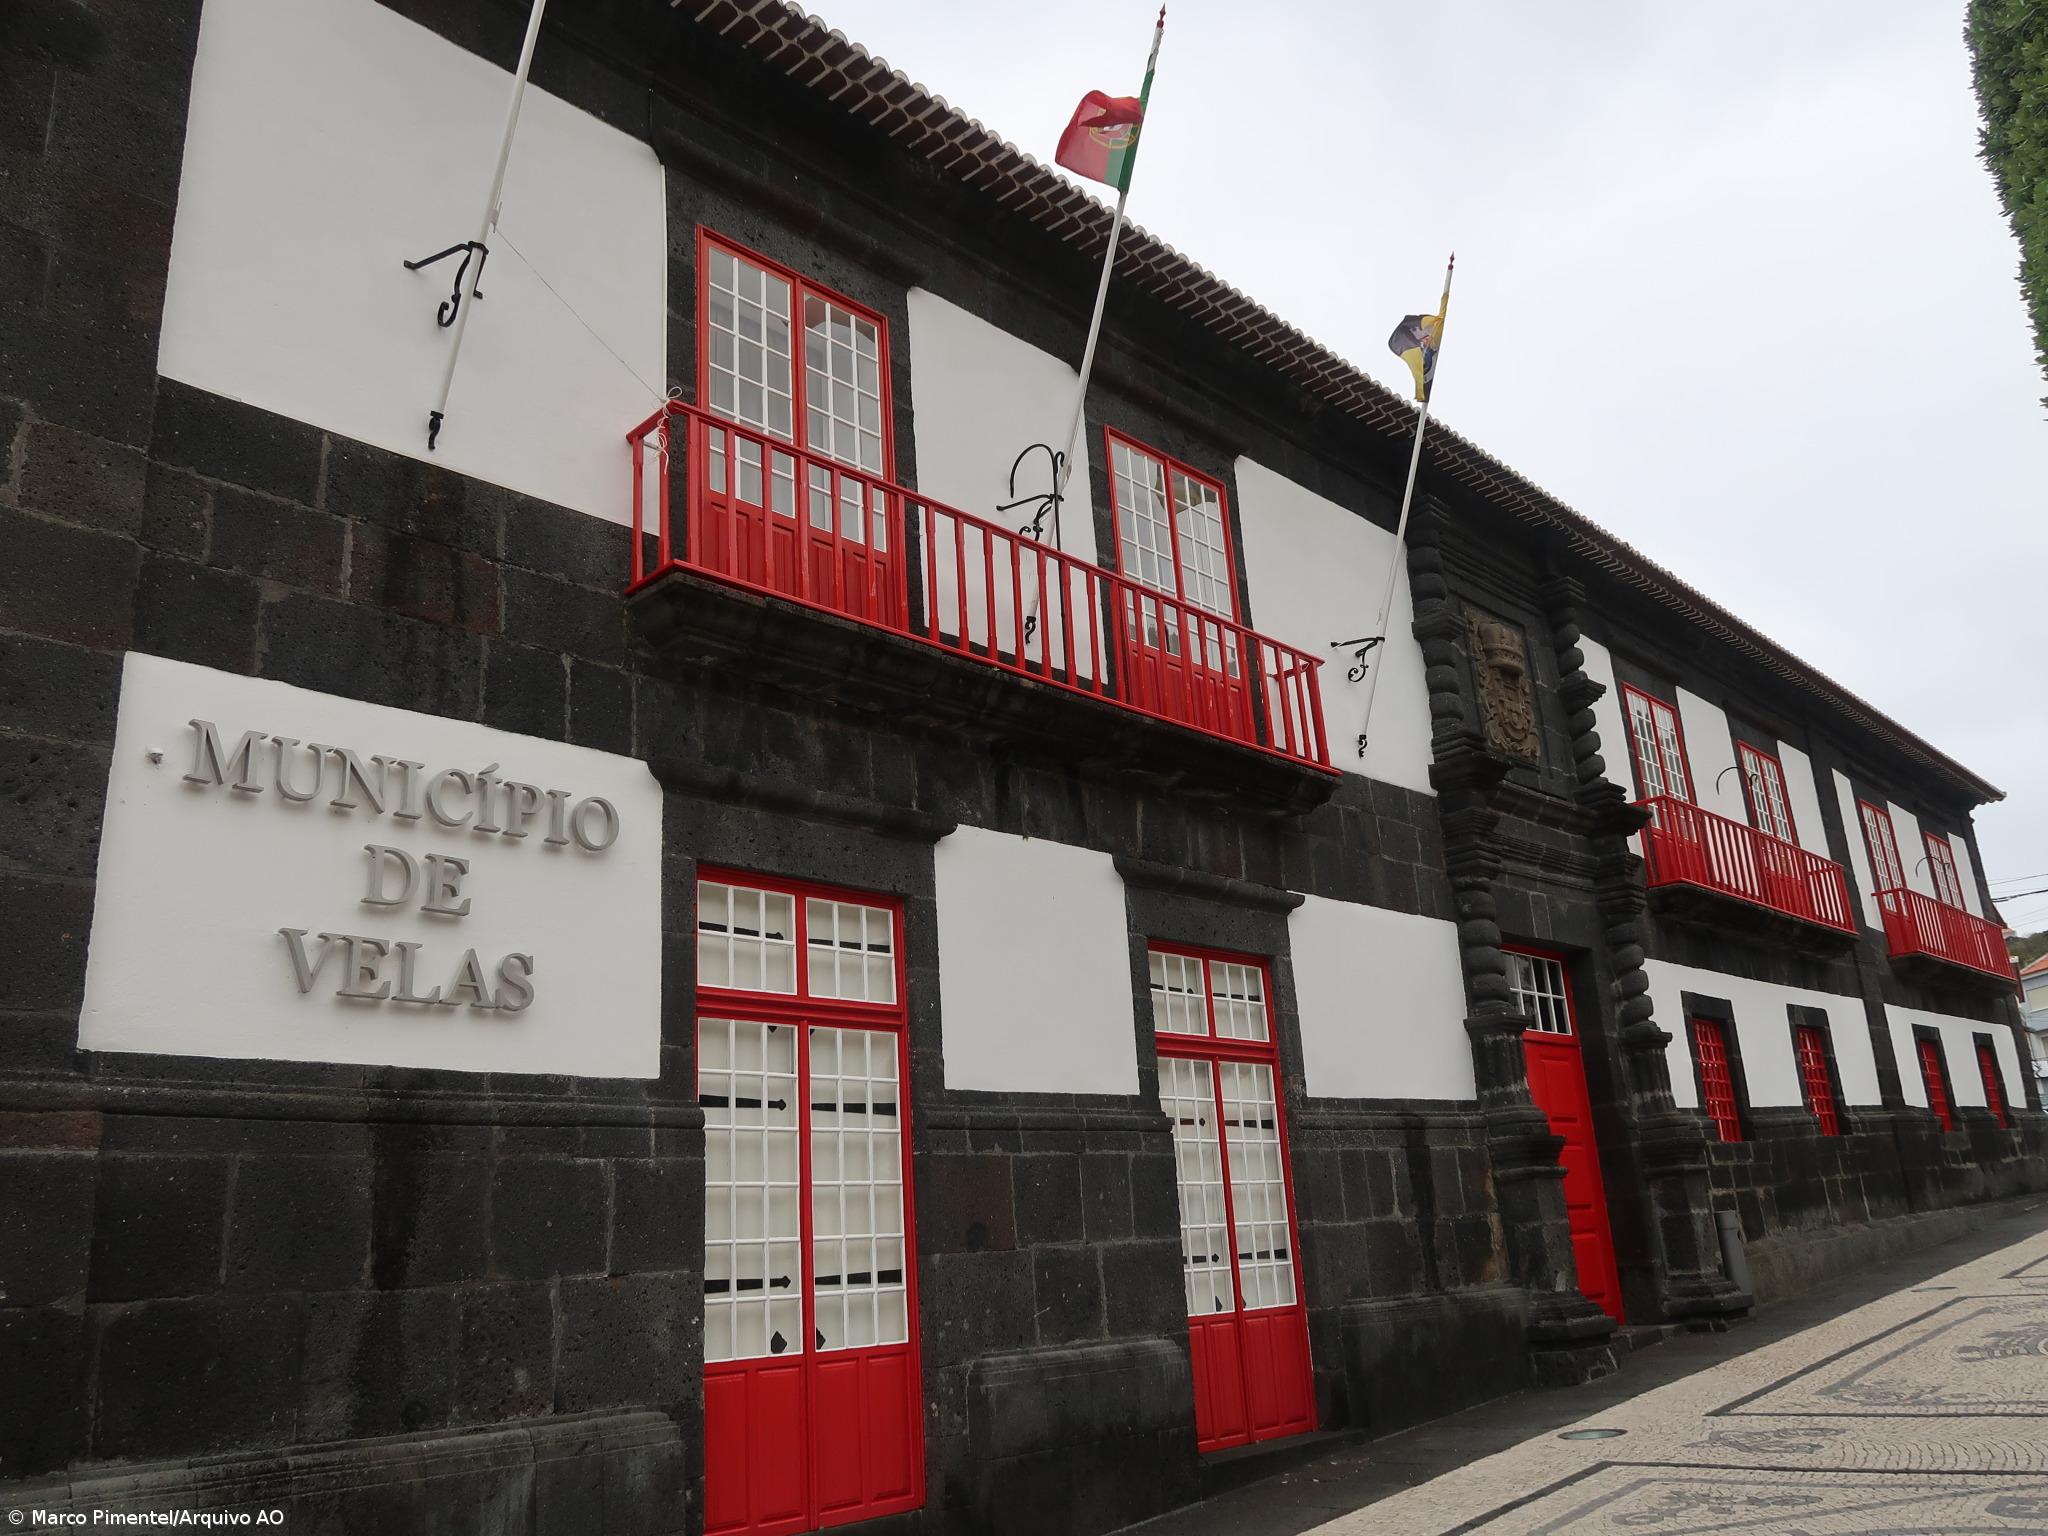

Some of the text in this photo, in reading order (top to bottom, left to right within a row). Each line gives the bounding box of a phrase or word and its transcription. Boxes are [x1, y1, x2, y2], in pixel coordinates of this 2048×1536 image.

[183, 719, 620, 852] MUNICÍPIO
[360, 844, 471, 916] DE
[278, 928, 535, 1011] VELAS
